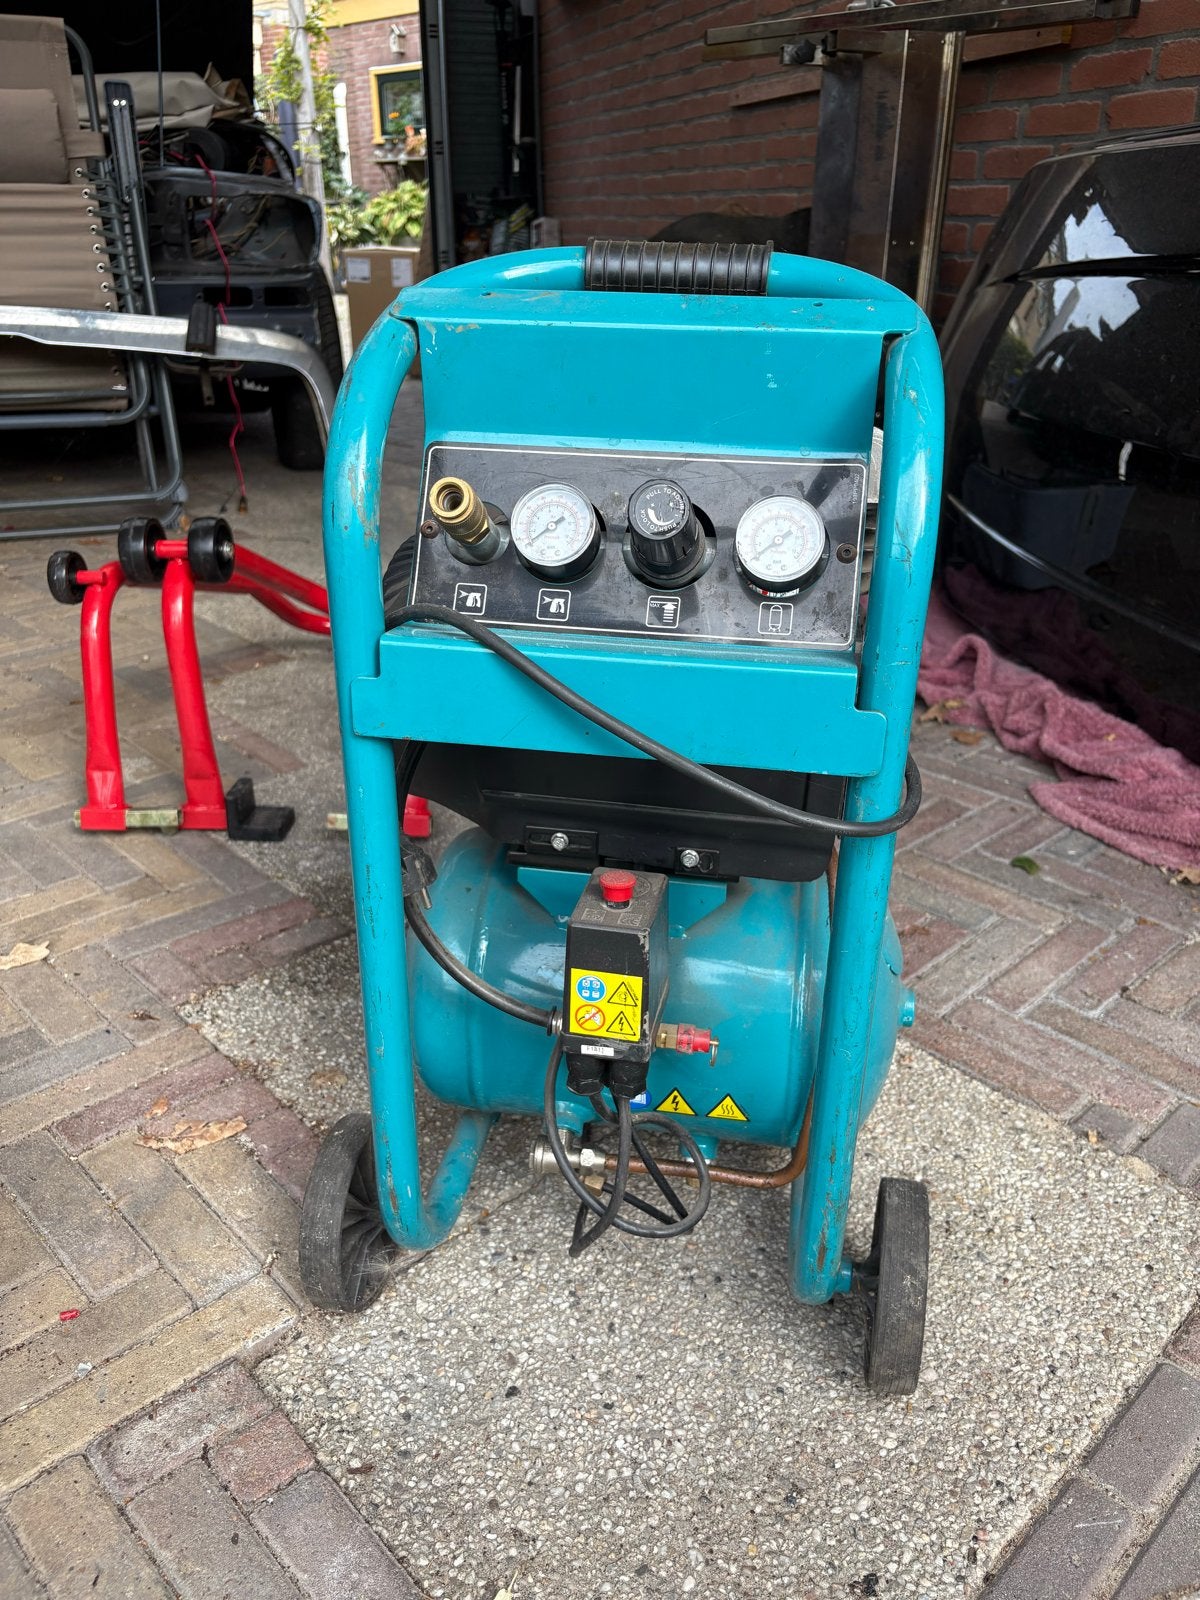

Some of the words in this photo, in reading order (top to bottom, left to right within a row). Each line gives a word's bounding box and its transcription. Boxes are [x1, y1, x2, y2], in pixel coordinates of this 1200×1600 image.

[646, 488, 661, 500] PULL
[640, 509, 650, 526] LOCK
[650, 524, 660, 532] TO
[660, 522, 677, 532] PUSH
